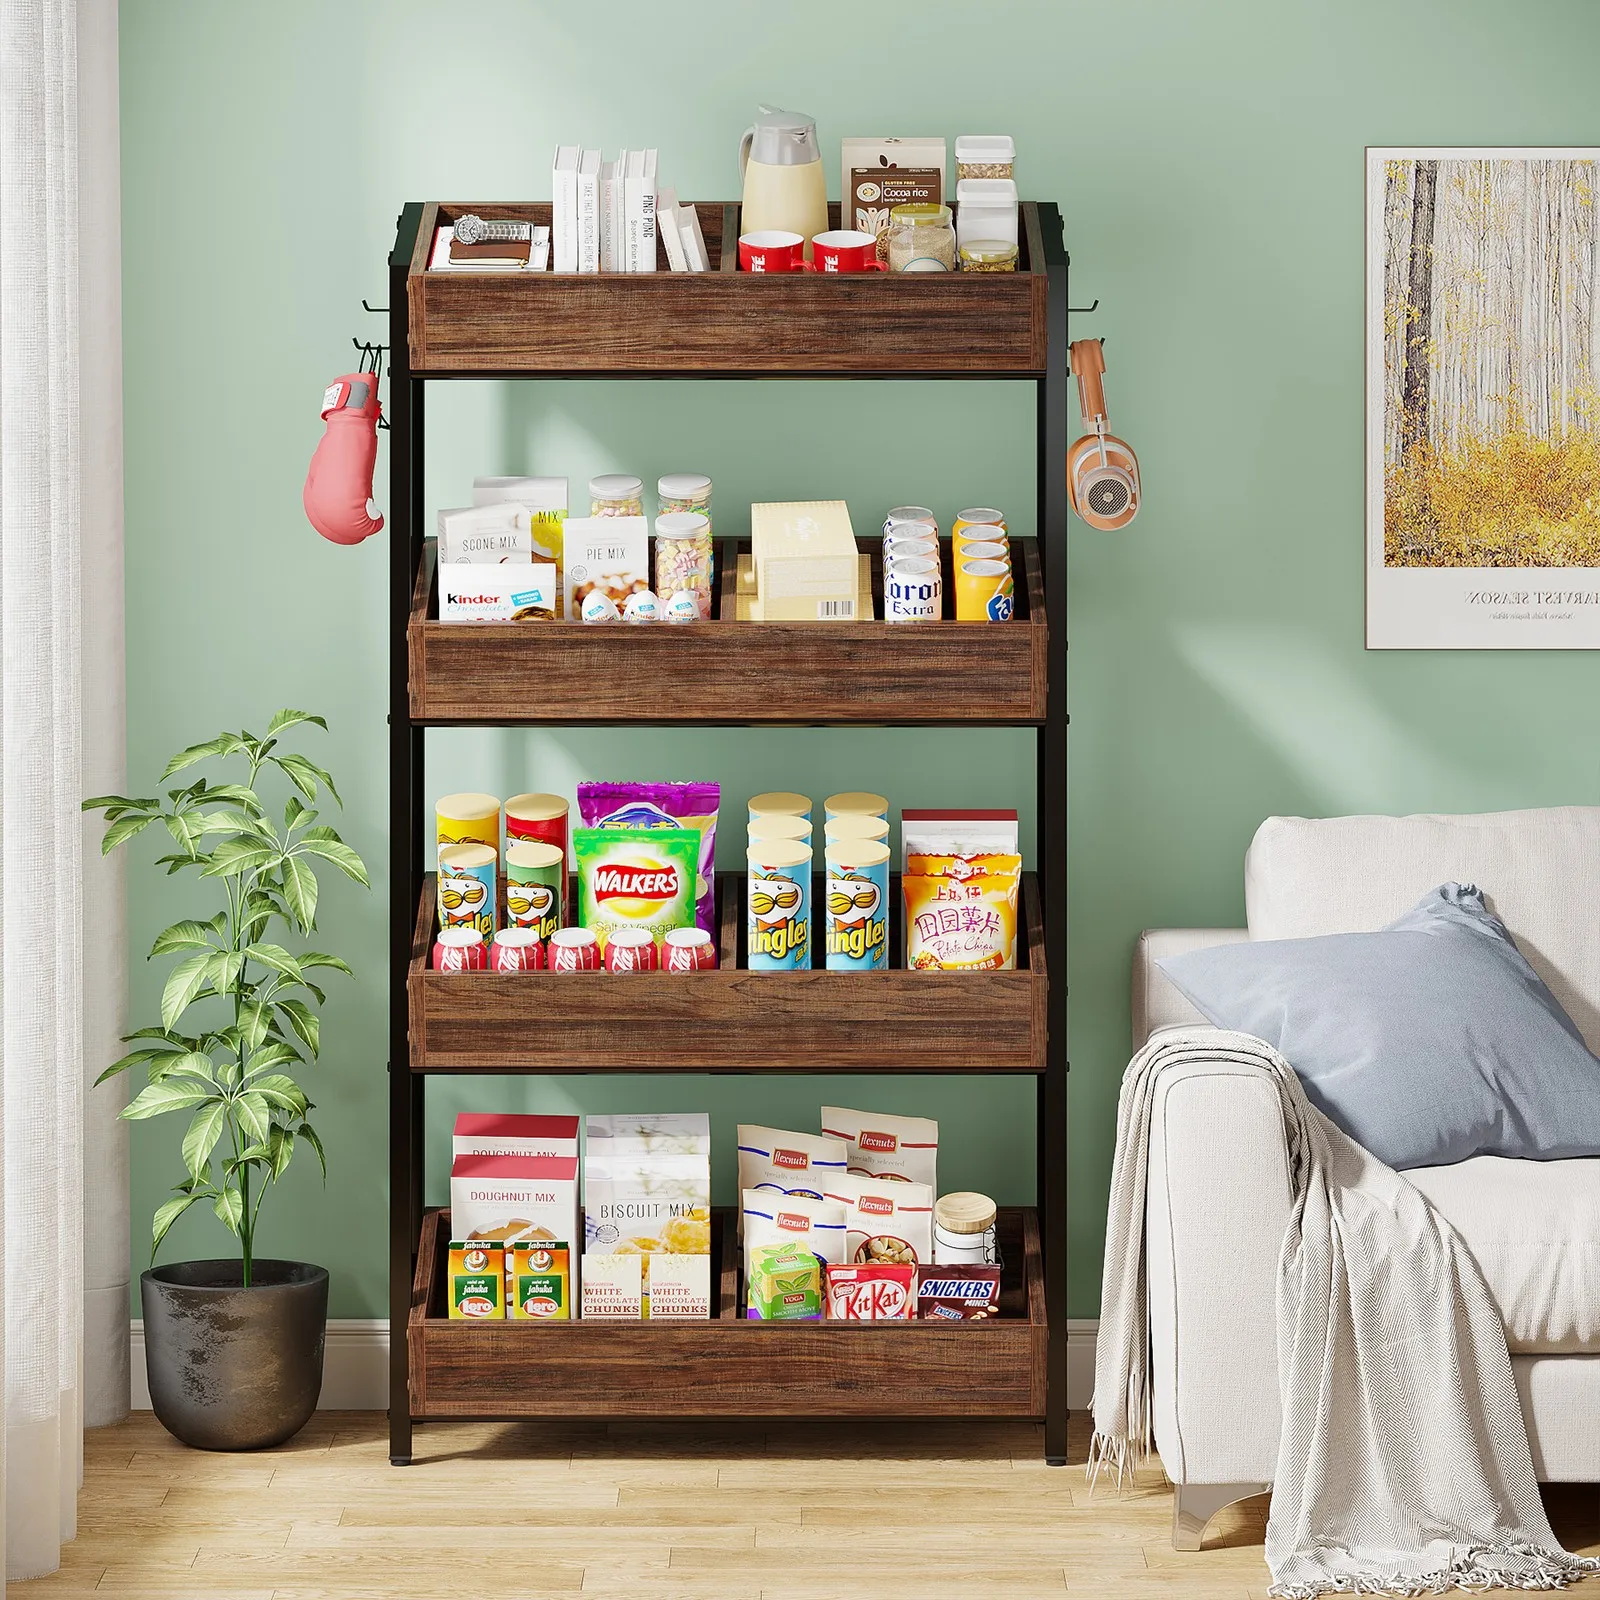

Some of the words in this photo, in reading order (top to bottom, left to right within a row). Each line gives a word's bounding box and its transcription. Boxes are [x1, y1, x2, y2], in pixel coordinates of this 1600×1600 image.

[883, 188, 911, 197] Cocoa
[912, 188, 929, 197] rice
[643, 195, 654, 214] PING
[643, 217, 654, 238] PONG
[538, 511, 558, 524] MIX
[462, 536, 495, 552] SCONE
[499, 535, 518, 549] MIX
[587, 548, 603, 560] PIE
[608, 547, 626, 560] MIX
[893, 601, 934, 616] Extra
[986, 593, 1014, 621] Fa
[594, 869, 679, 894] WALKERS
[861, 1131, 896, 1148] flexnuts
[473, 1149, 534, 1157] DOUGHNUT
[774, 1148, 808, 1165] flexnuts
[470, 1191, 532, 1202] DOUGHNUT
[535, 1193, 556, 1202] MIX
[859, 1195, 893, 1212] flexnuts
[600, 1203, 660, 1219] BISCUIT
[669, 1203, 695, 1217] MIX
[584, 1288, 623, 1296] WHITE
[652, 1288, 691, 1296] WHITE
[919, 1280, 994, 1298] SNICKERS
[784, 1293, 804, 1303] YOGA
[963, 1299, 990, 1307] MINIS
[584, 1305, 639, 1313] CHUNKS
[652, 1305, 708, 1313] CHUNKS
